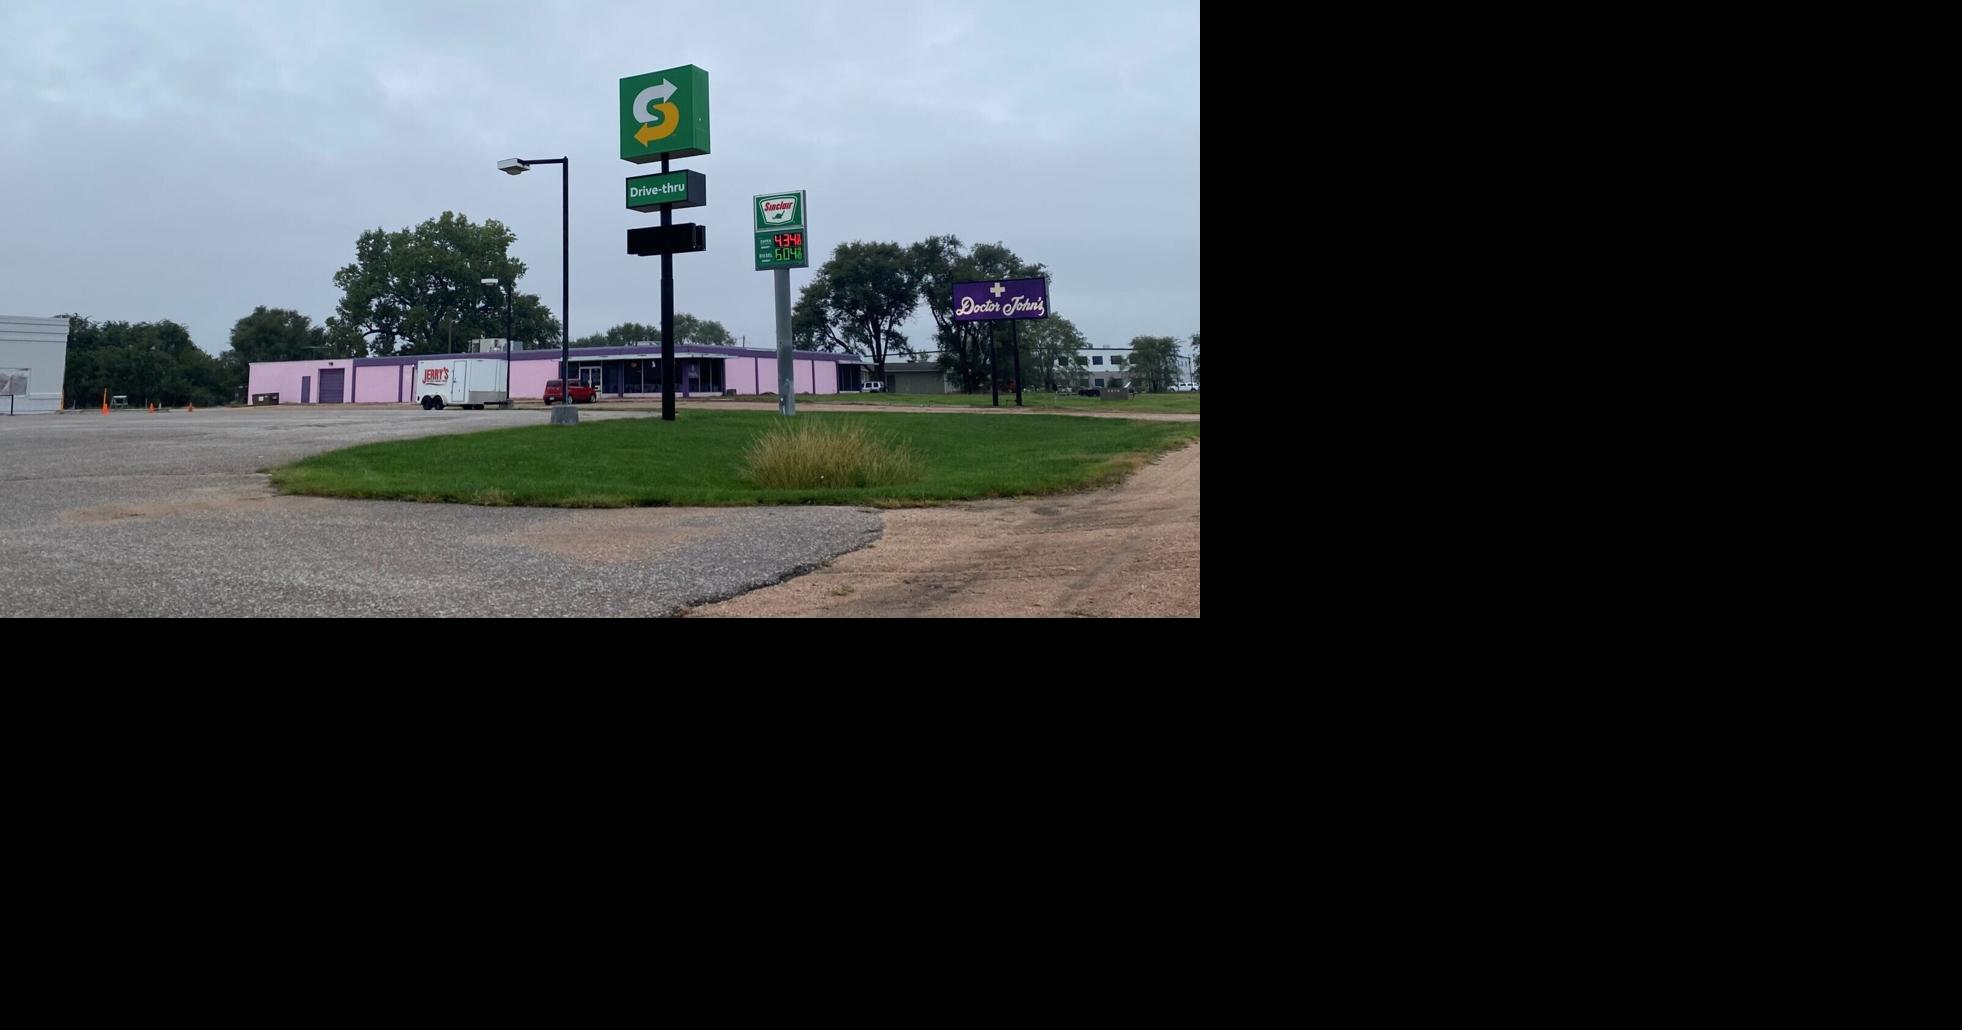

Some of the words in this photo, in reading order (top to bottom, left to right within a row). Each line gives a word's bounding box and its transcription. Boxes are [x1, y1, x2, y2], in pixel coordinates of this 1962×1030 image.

[630, 182, 685, 197] Drive-thru
[764, 201, 793, 211] Sinclair
[955, 296, 1000, 316] Doctor
[1002, 295, 1045, 316] John's
[422, 367, 449, 384] JERRY'S
